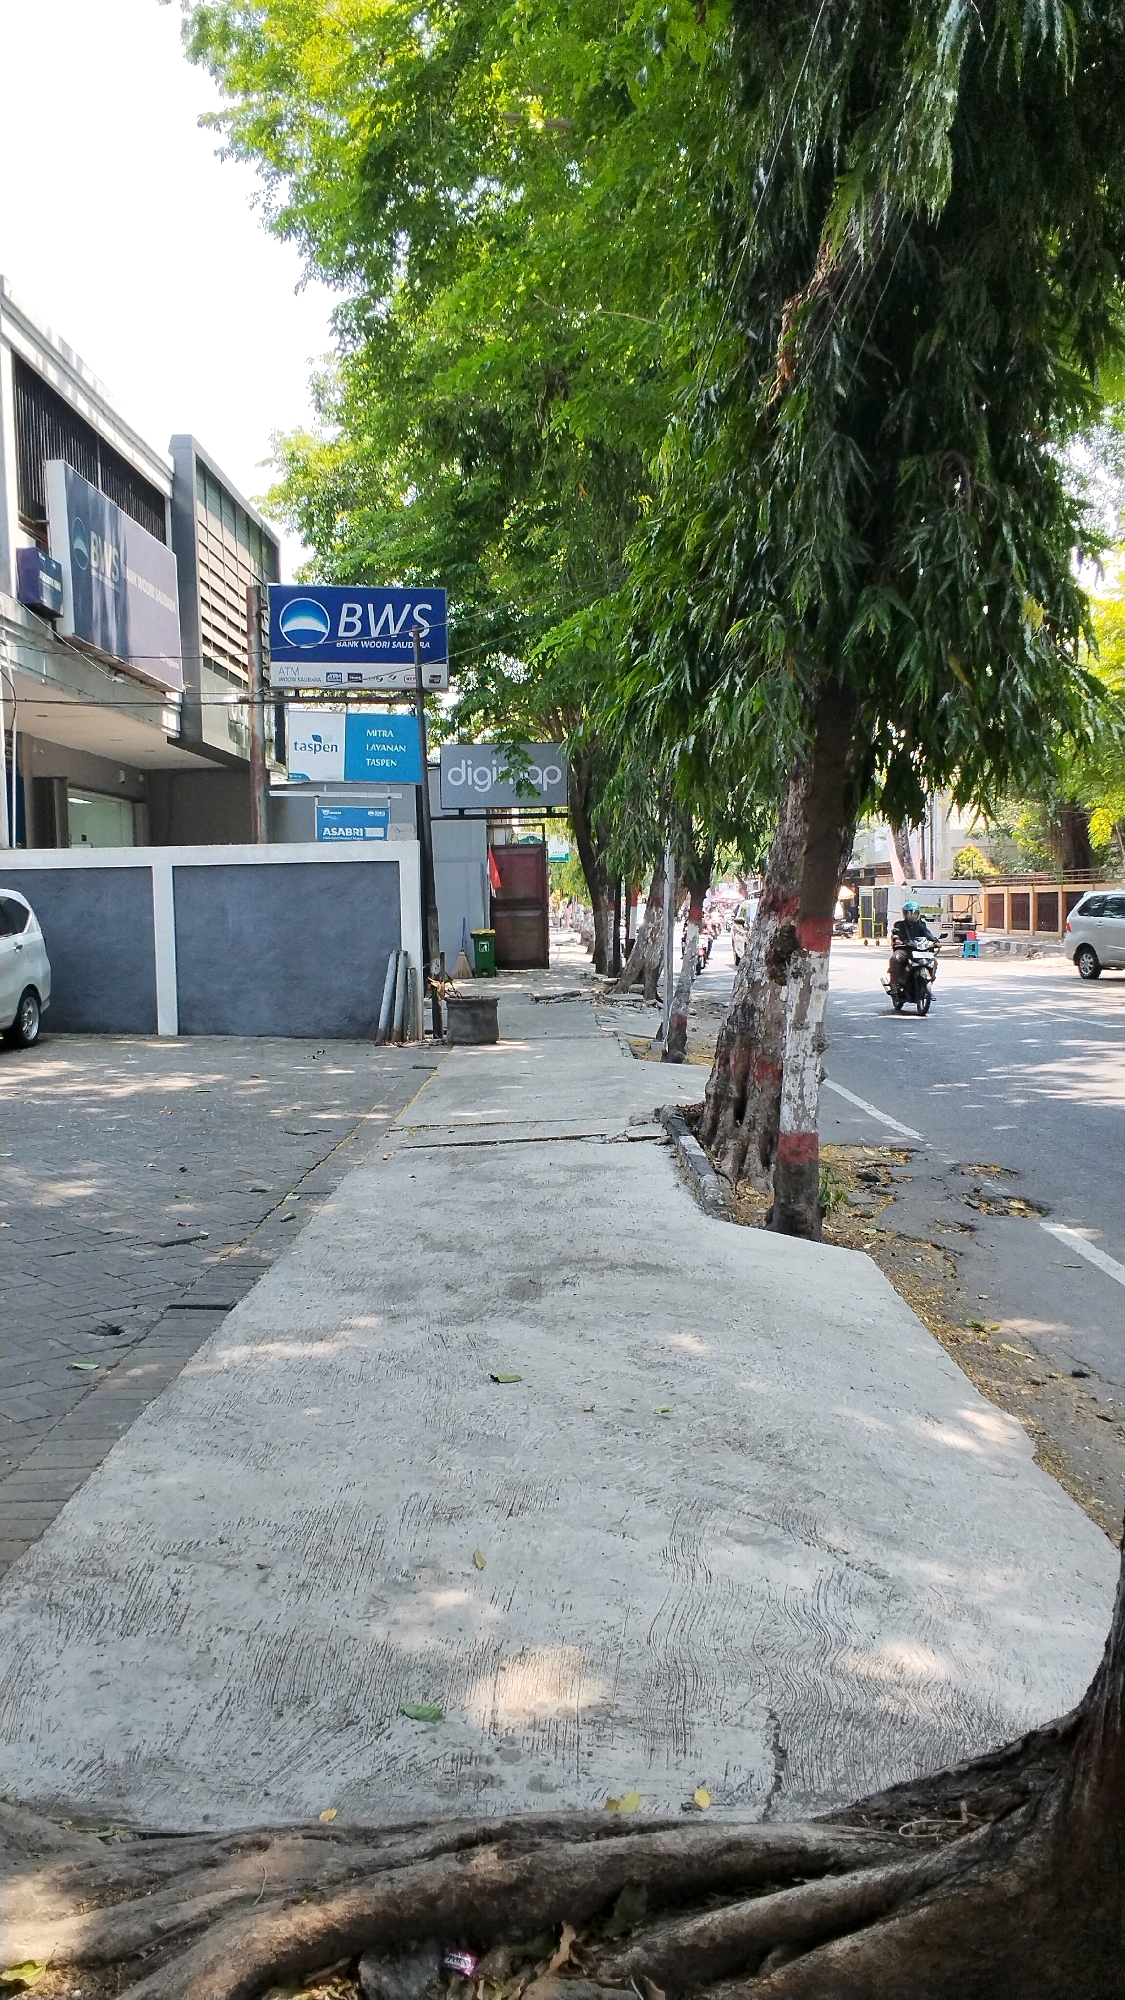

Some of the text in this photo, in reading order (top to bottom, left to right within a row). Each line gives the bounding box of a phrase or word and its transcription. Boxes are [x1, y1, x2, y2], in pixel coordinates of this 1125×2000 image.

[91, 531, 119, 583] BWS
[338, 603, 432, 638] BWS
[336, 640, 430, 649] BANK WOORI SAUDRA
[279, 666, 300, 676] ATM
[366, 729, 394, 738] MITRA
[293, 740, 339, 755] taspen
[366, 743, 407, 753] LAYANAN
[366, 758, 398, 767] TASPEN
[322, 827, 364, 837] ASABRI
